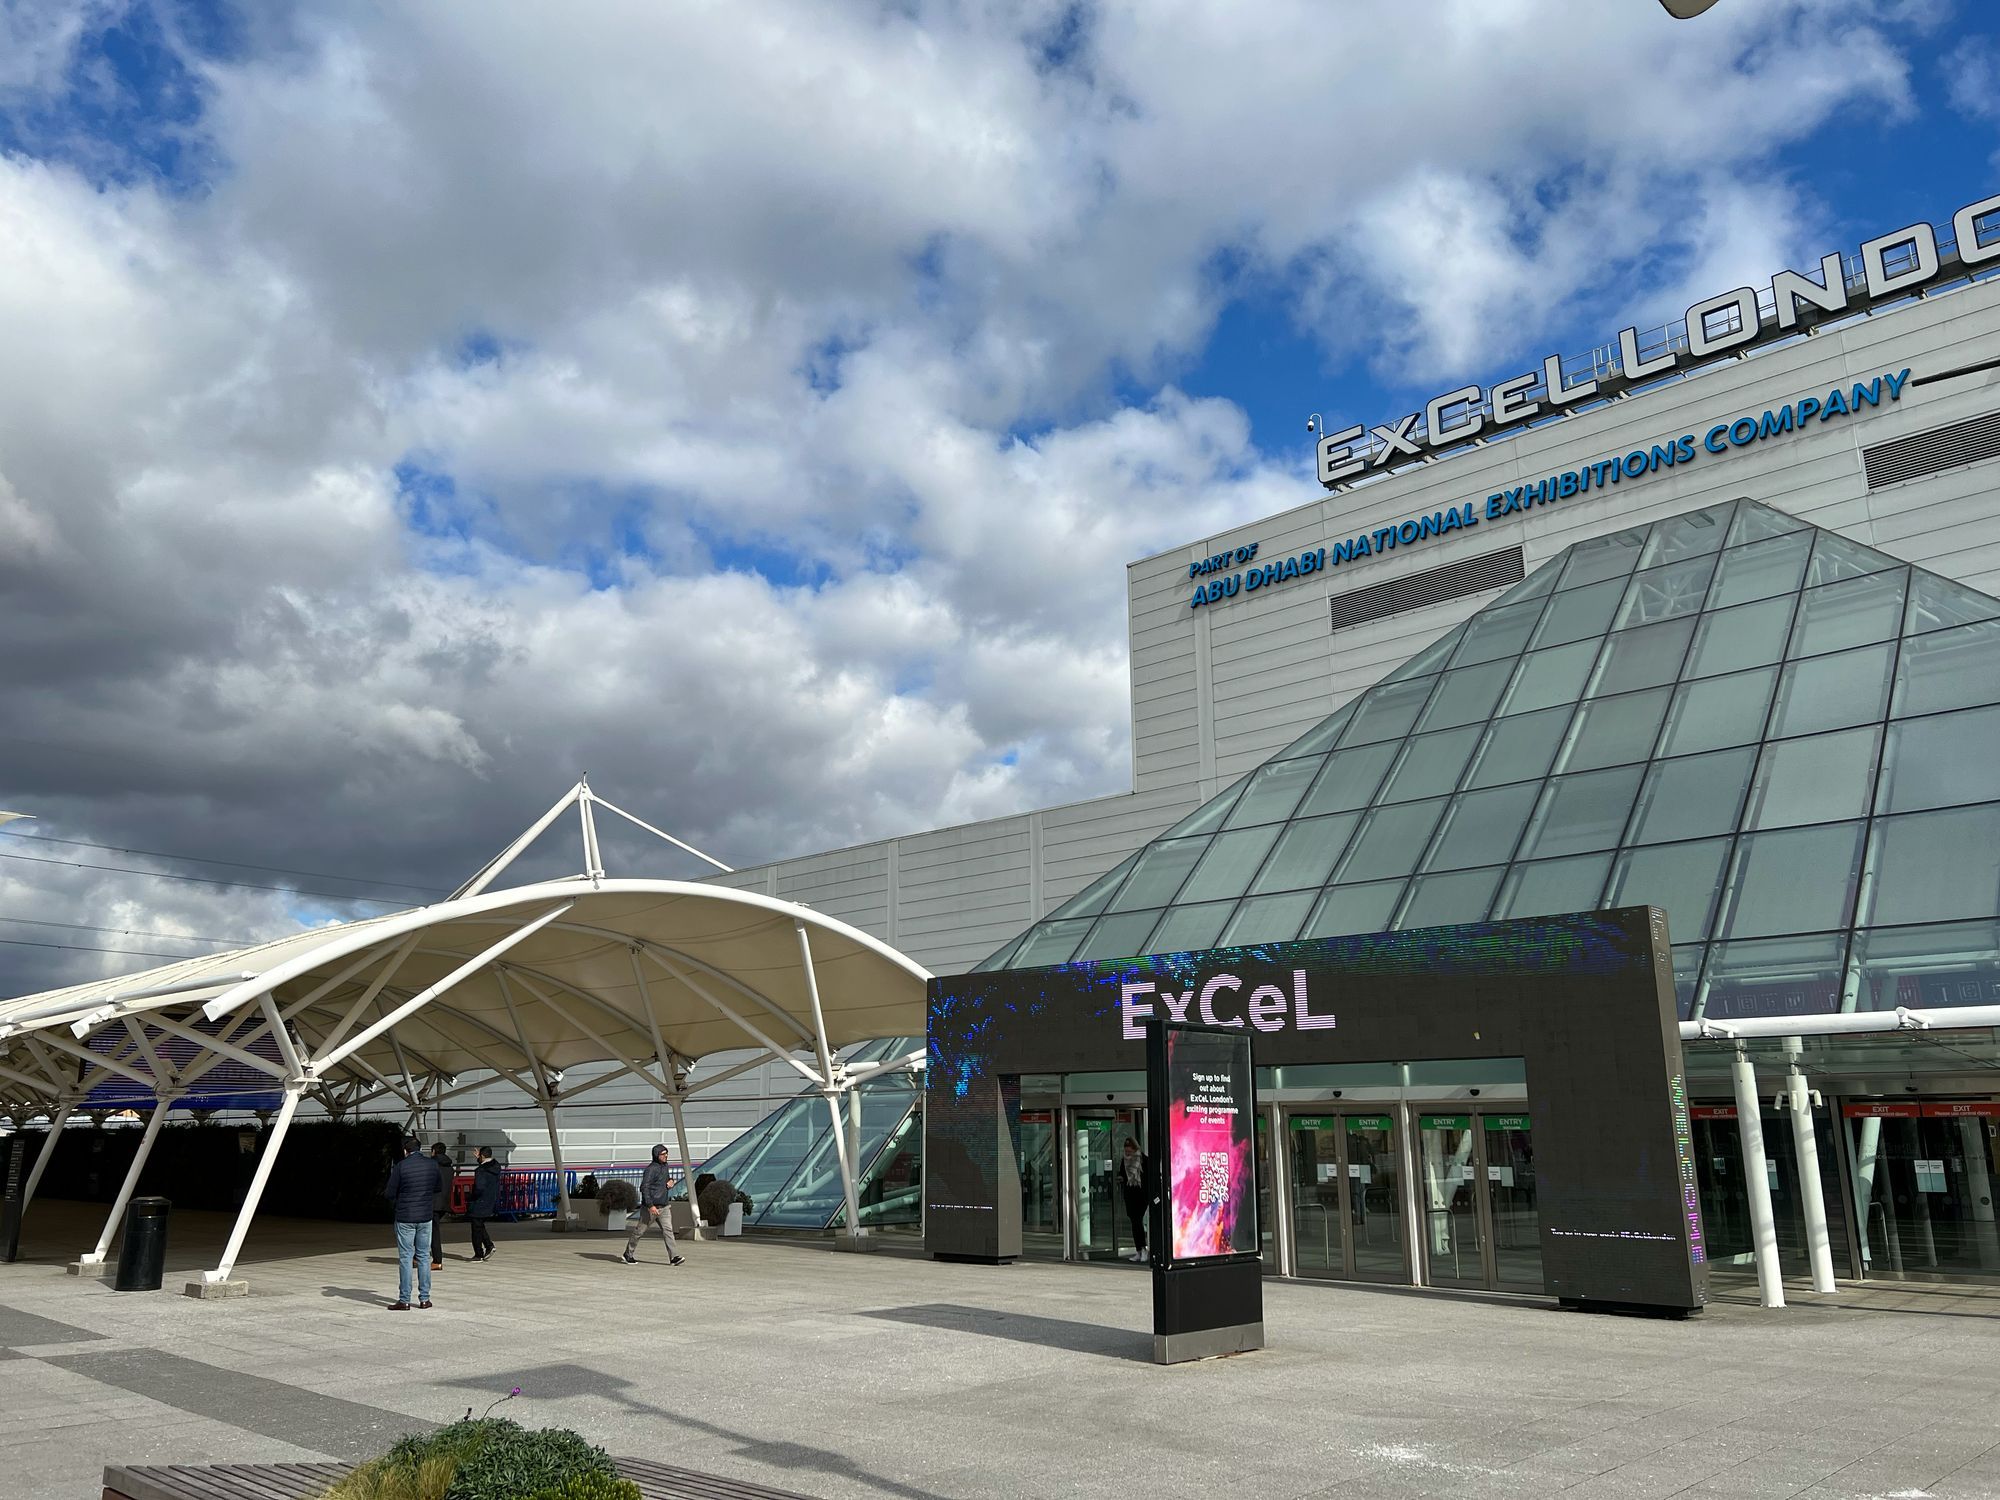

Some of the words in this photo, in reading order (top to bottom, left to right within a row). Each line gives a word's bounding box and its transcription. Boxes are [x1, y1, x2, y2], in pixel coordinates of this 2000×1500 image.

[1191, 573, 1241, 608] ABU
[1245, 547, 1326, 592] DHABI
[1332, 503, 1478, 565] NATIONAL
[1485, 434, 1696, 519] EXHIBITIONS
[1704, 368, 1911, 454] COMPANY
[1189, 551, 1233, 578] PART
[1234, 542, 1259, 563] OF
[1121, 969, 1336, 1040] ExCeL
[1192, 1072, 1205, 1083] Sign
[1206, 1074, 1213, 1083] up
[1214, 1074, 1220, 1082] to
[1221, 1074, 1231, 1083] find
[1200, 1084, 1209, 1092] out
[1210, 1084, 1225, 1093] about
[1209, 1095, 1234, 1104] London's
[1186, 1105, 1208, 1114] exciting
[1209, 1106, 1238, 1115] programme
[1200, 1116, 1207, 1124] of
[1208, 1117, 1225, 1125] events
[1433, 1118, 1455, 1126] ENTRY
[1500, 1118, 1523, 1126] ENTRY
